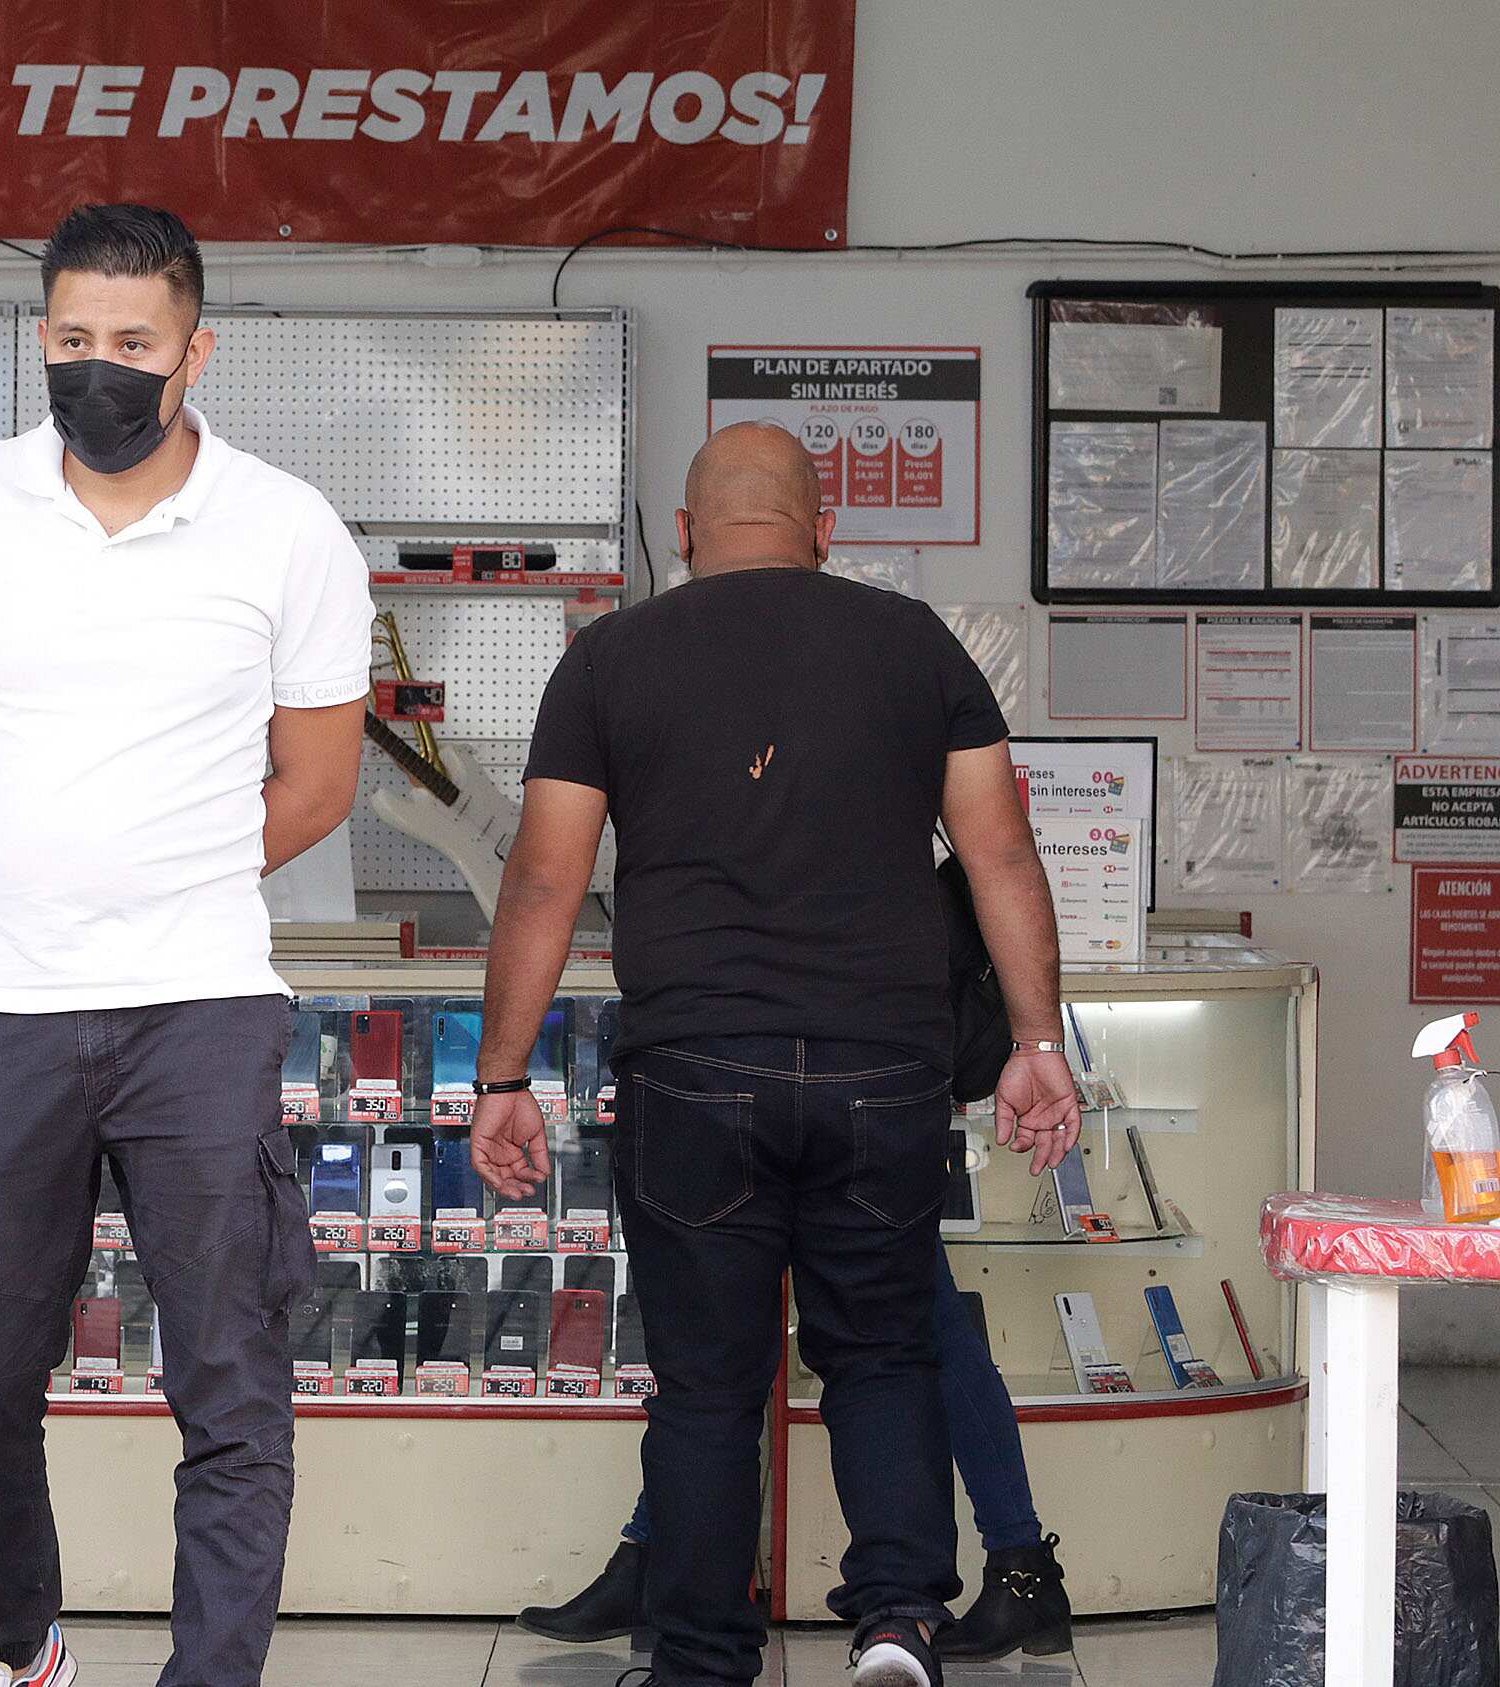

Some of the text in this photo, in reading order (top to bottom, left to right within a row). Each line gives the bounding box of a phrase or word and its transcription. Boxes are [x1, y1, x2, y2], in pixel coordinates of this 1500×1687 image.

[11, 63, 145, 137] TE
[157, 66, 827, 145] PRESTAMOS!
[754, 359, 932, 376] PLAN DE APARTADO
[791, 380, 898, 399] SIN INTERÉS
[810, 404, 839, 413] PLAZO
[840, 404, 852, 413] DE
[806, 425, 834, 438] 120
[856, 425, 885, 438] 150
[905, 425, 934, 438] 180
[561, 577, 608, 585] APARTADO
[1016, 767, 1055, 779] meses
[1030, 785, 1107, 798] sin intereses
[1422, 786, 1450, 797] ESTA
[1432, 801, 1494, 812] NO ACEPTA
[1402, 814, 1500, 827] ARTÍCULOS ROBA
[1038, 843, 1108, 856] intereses
[1438, 880, 1492, 896] ATENCIÓN
[283, 1101, 305, 1113] 290
[365, 1099, 386, 1111] 350
[448, 1102, 469, 1114] 350
[325, 1227, 346, 1239] 260
[383, 1228, 405, 1240] 260
[448, 1229, 469, 1241] 260
[510, 1225, 532, 1237] 260
[572, 1230, 594, 1242] 250
[91, 1378, 108, 1389] 170
[297, 1379, 318, 1392] 200
[361, 1380, 383, 1392] 220
[433, 1379, 454, 1392] 250
[499, 1382, 520, 1393] 250
[563, 1381, 584, 1394] 250
[632, 1381, 653, 1393] 250
